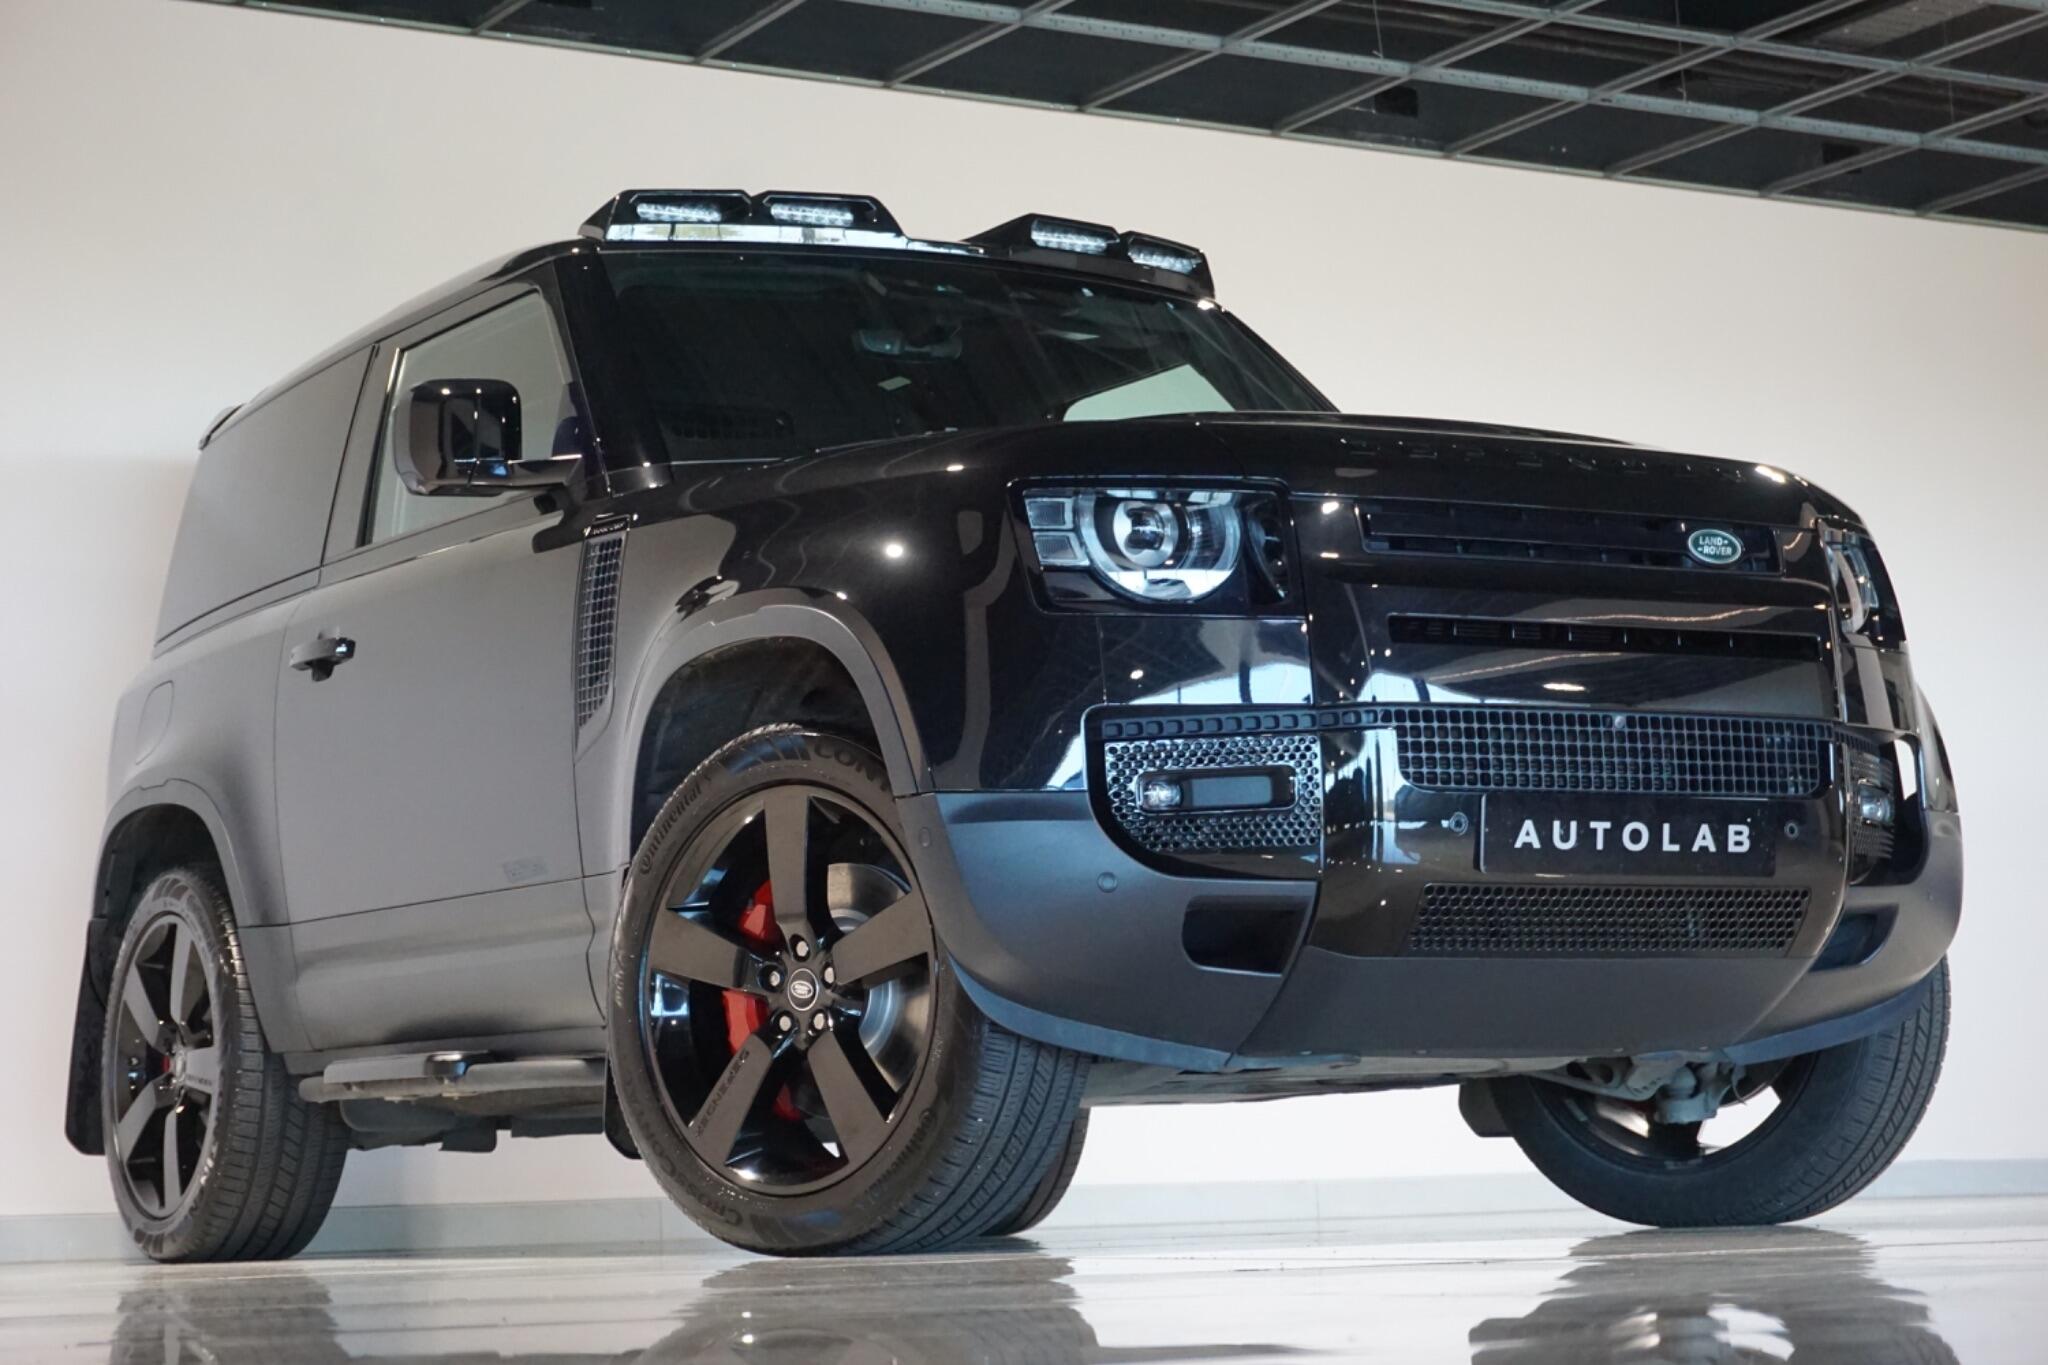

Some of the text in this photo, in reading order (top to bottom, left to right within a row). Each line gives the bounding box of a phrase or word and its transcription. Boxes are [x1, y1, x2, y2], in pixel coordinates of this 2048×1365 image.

[1699, 536, 1723, 546] LAND
[1703, 545, 1733, 556] ROVER
[1513, 819, 1751, 853] AUTOLAB
